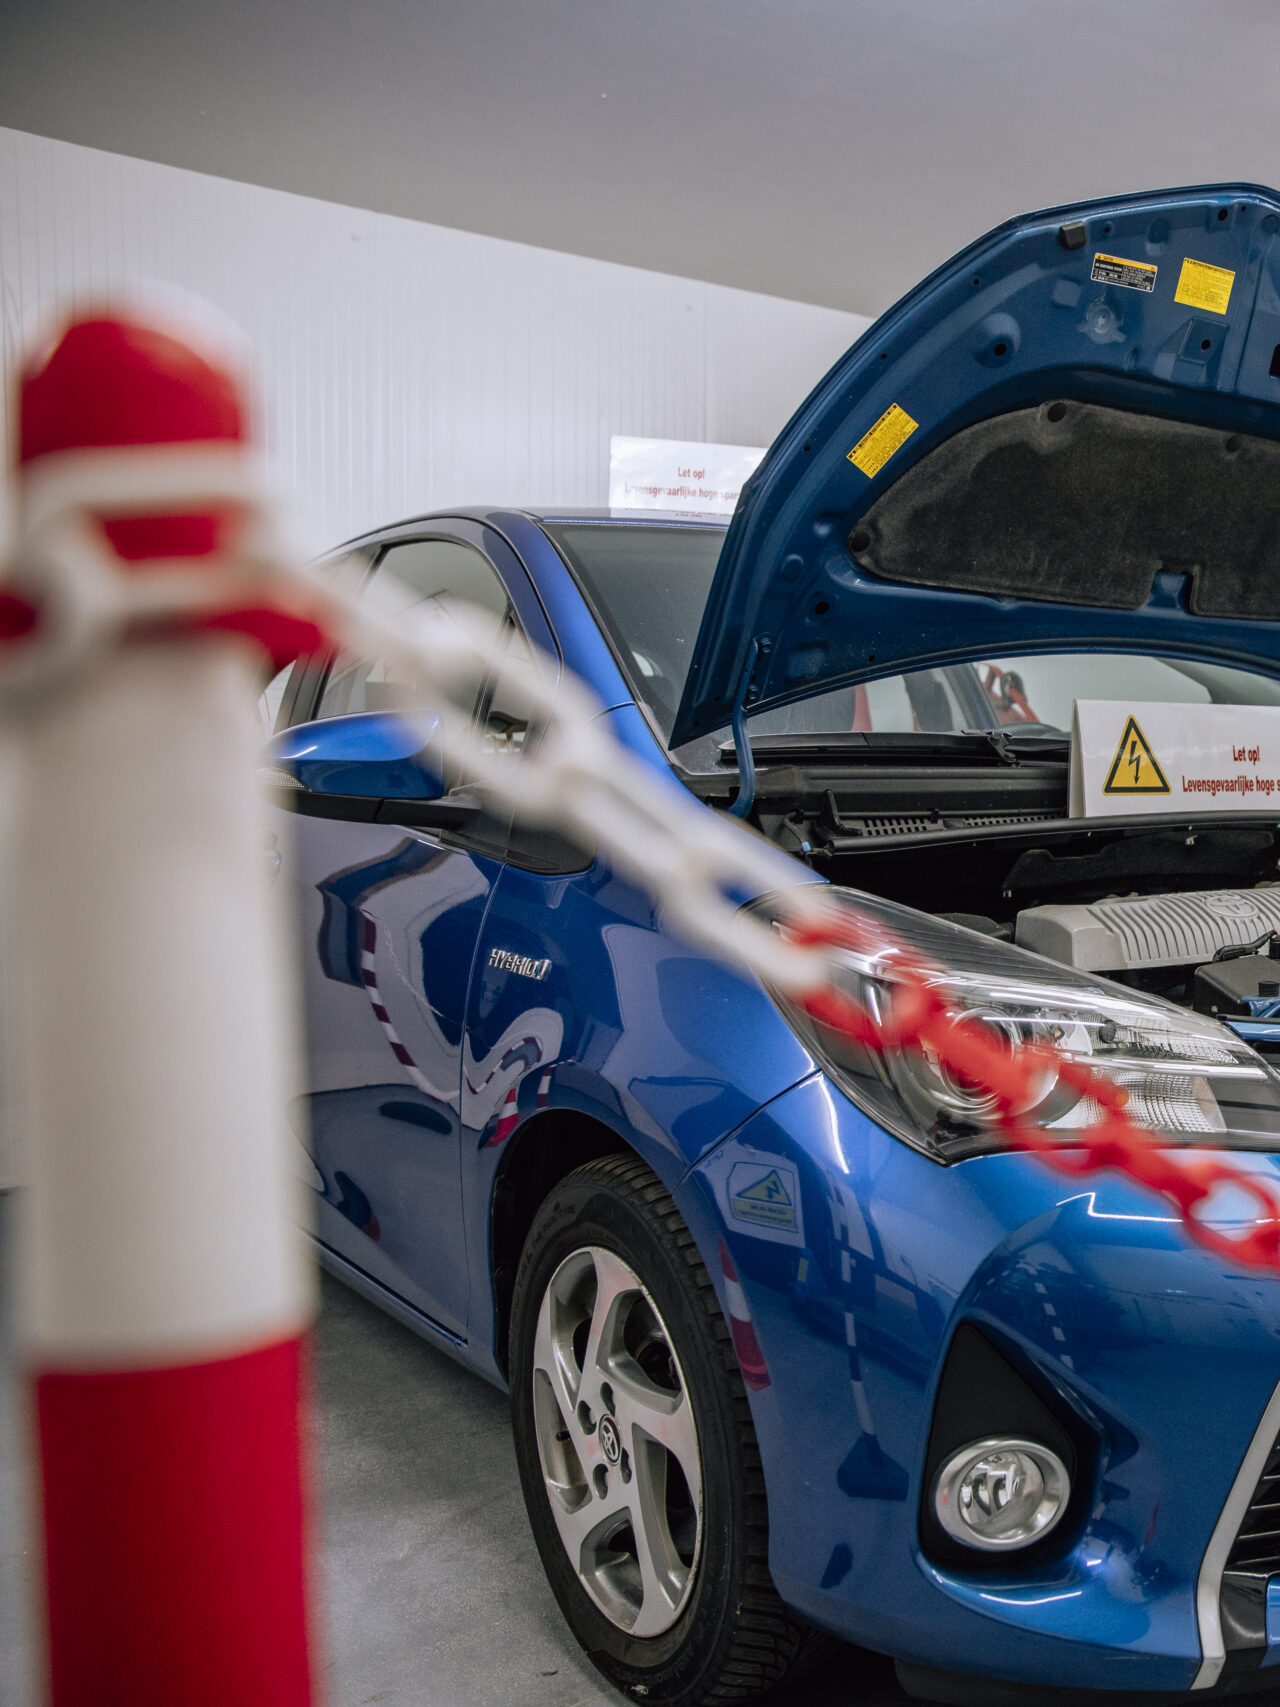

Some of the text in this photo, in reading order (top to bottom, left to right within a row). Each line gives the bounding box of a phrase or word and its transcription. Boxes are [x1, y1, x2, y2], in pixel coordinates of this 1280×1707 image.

[677, 467, 705, 480] Let op!
[699, 488, 718, 500] hoge
[1232, 745, 1260, 766] Let op!
[1182, 775, 1254, 796] Levensgevaarlijke
[1255, 775, 1275, 796] hoge
